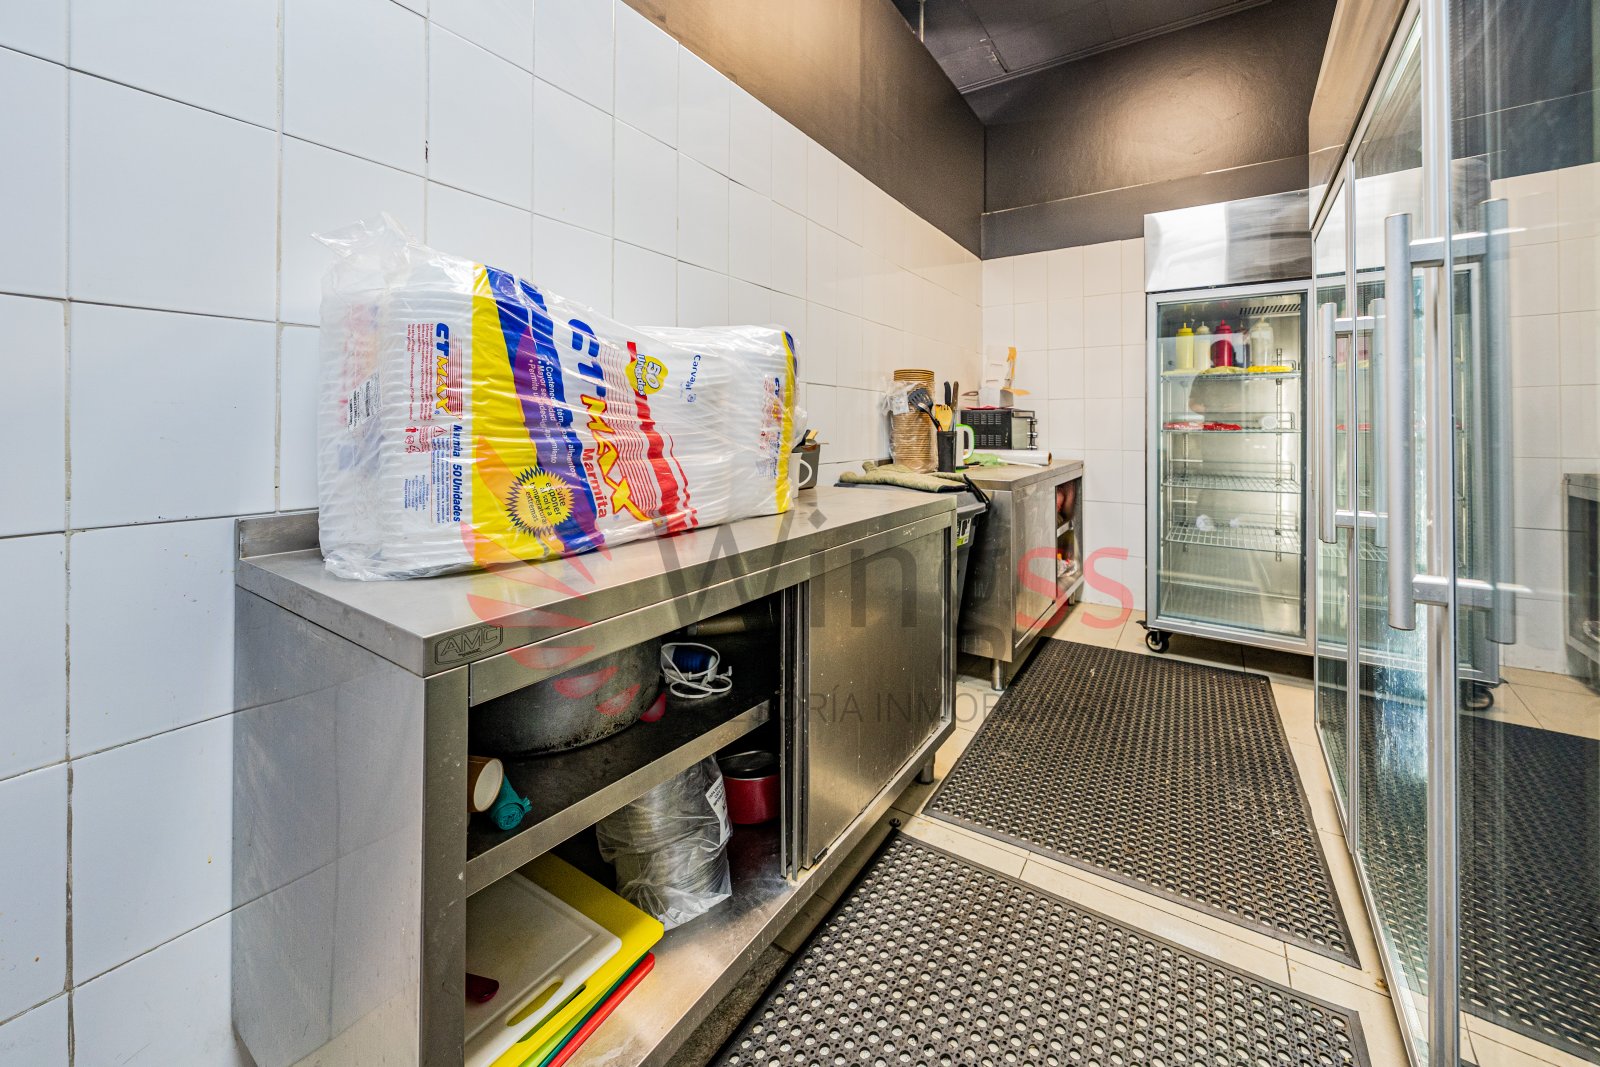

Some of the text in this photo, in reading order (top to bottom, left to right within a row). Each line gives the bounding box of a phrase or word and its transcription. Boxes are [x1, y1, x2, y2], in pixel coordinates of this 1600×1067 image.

[528, 364, 538, 391] Permite
[537, 365, 546, 387] Mayor
[634, 353, 647, 396] Unidades
[645, 361, 661, 389] 50
[453, 464, 463, 477] 50
[583, 448, 608, 518] Marmita
[453, 480, 463, 522] Unidades
[543, 495, 551, 505] sol
[556, 487, 566, 507] Evite
[441, 626, 499, 656] AMC
